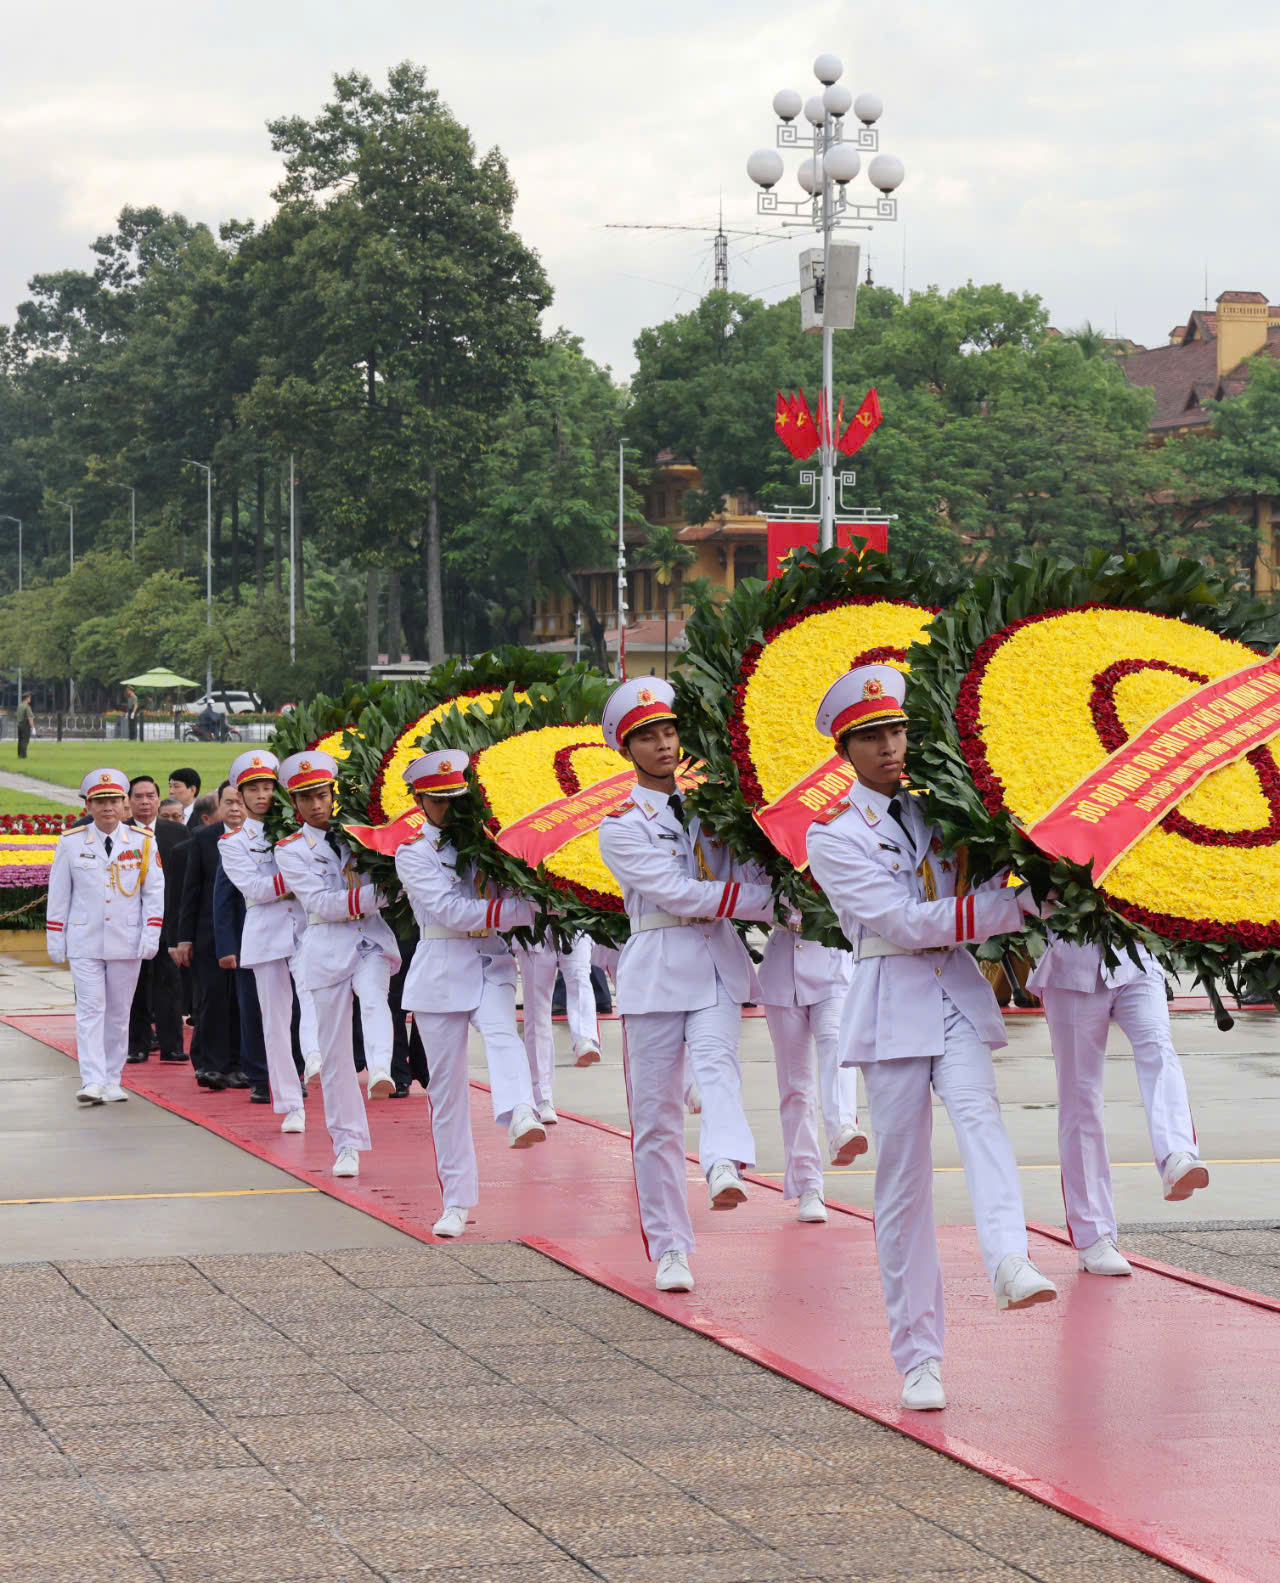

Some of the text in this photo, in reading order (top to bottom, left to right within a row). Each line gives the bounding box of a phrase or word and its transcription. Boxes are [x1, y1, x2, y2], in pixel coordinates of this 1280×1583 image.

[1223, 684, 1270, 710] MINH
[1246, 675, 1280, 695] VĨ
[1192, 702, 1227, 728] HỒ
[1208, 694, 1244, 720] CHÍ
[1168, 716, 1213, 742] TỊCH
[1148, 728, 1190, 758] CHỦ
[1132, 751, 1168, 771] ƠN
[1134, 794, 1162, 813] BAN
[1148, 780, 1177, 800] CHẤP
[1182, 750, 1216, 769] TRUNG
[1218, 730, 1248, 747] ĐẢNG
[1107, 763, 1152, 792] NHỚ
[797, 786, 832, 812] ĐỜI
[816, 772, 850, 796] ĐỜI
[1088, 783, 1130, 807] ĐỜI
[1069, 799, 1111, 824] ĐỜI
